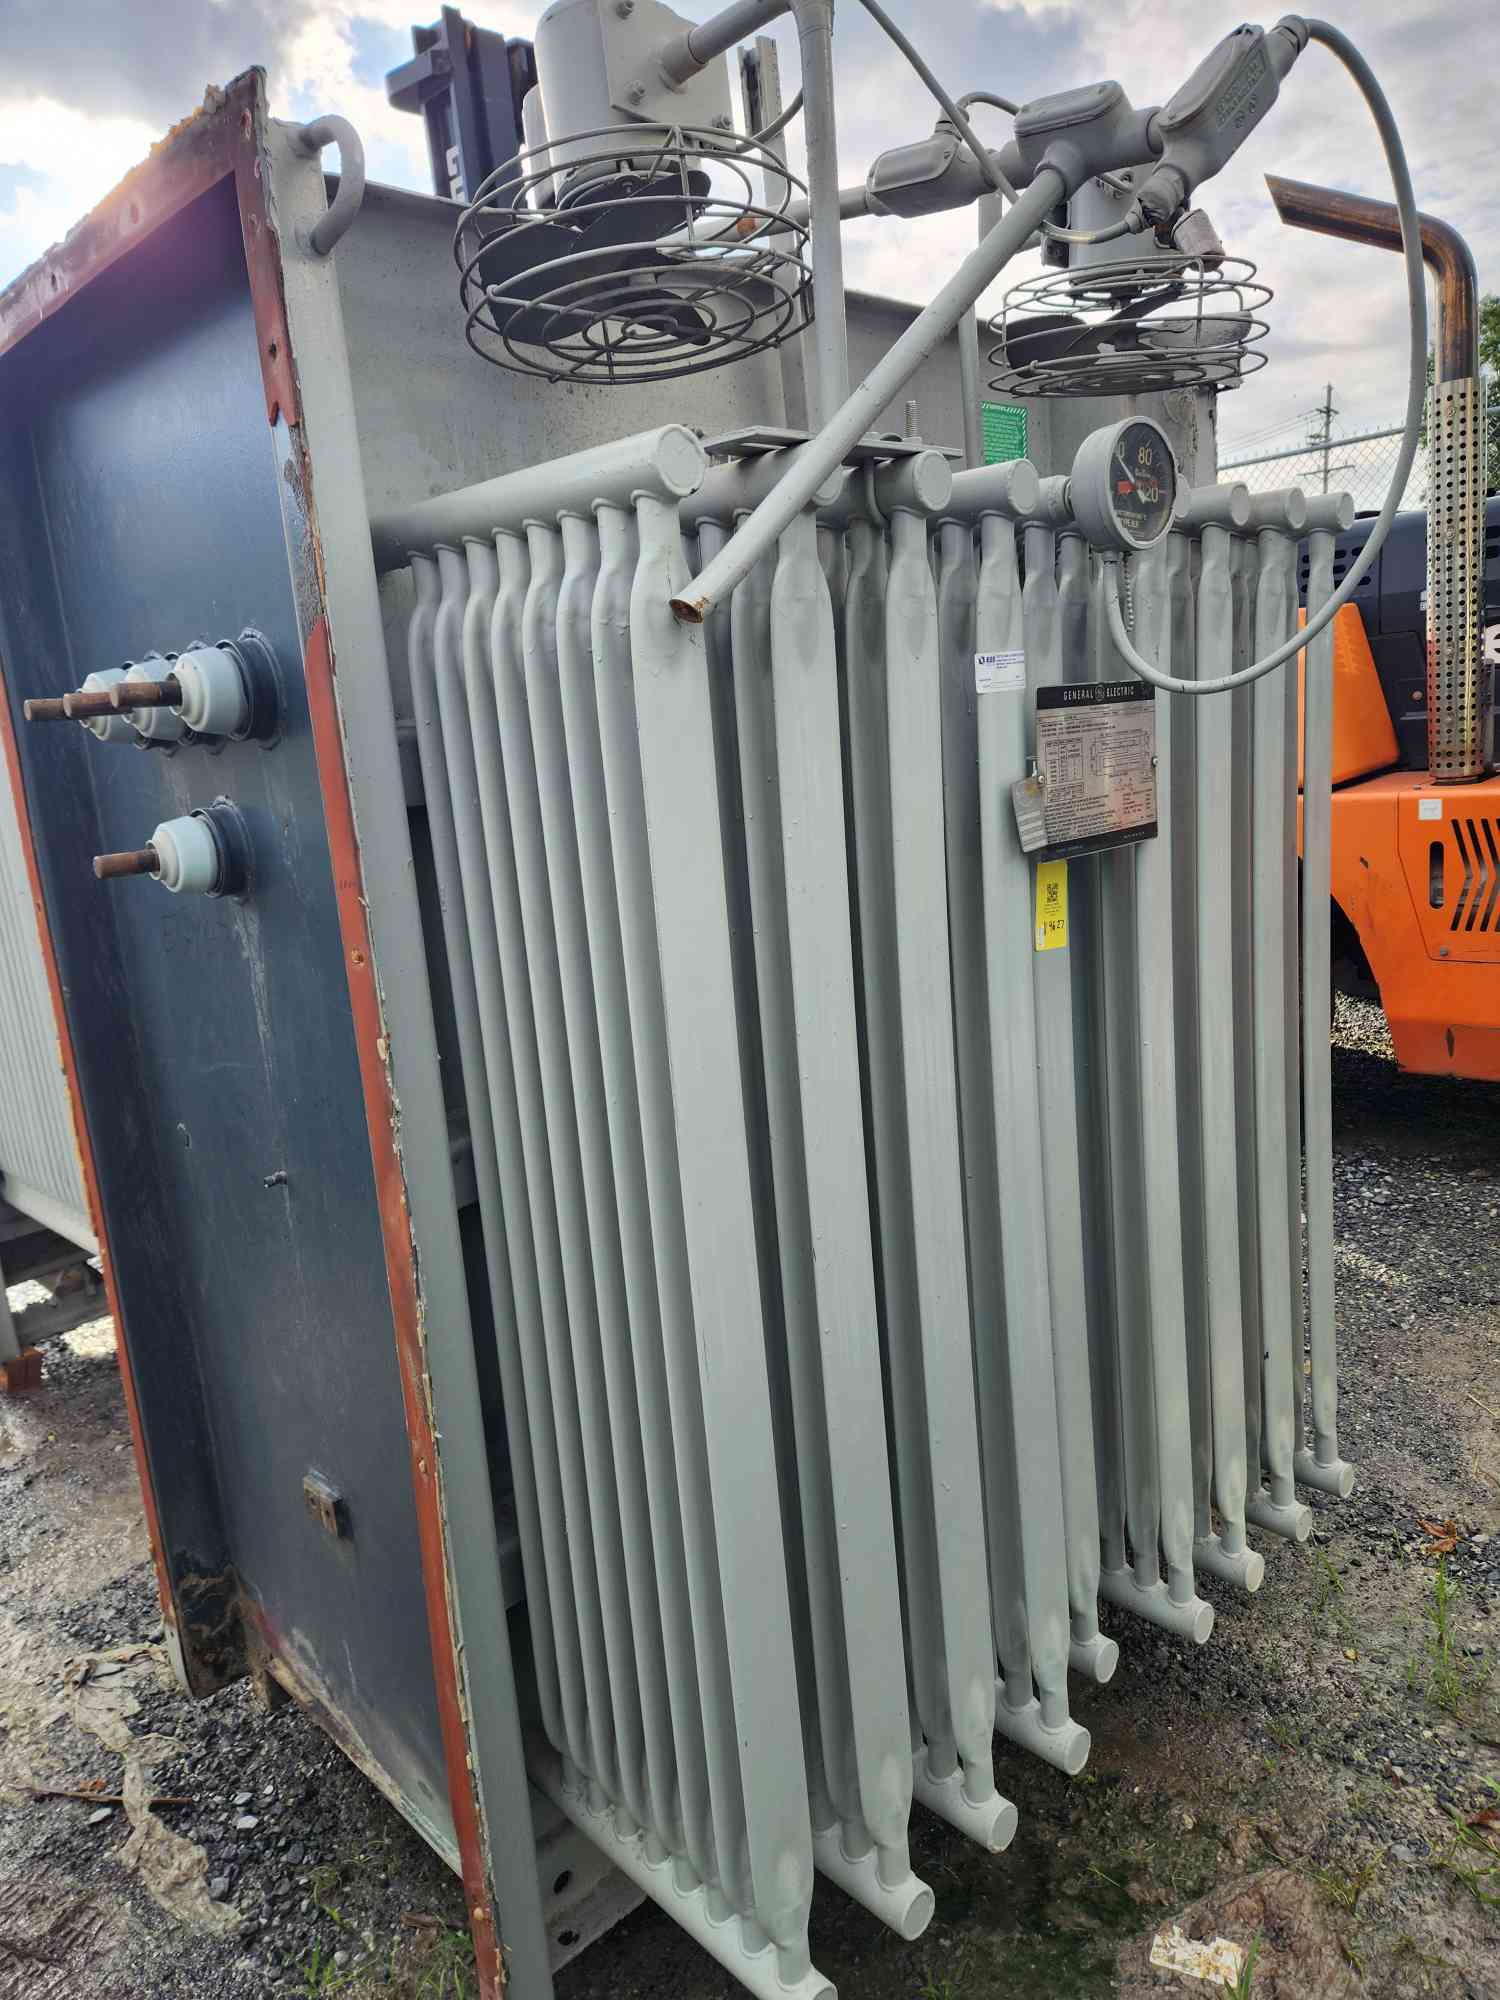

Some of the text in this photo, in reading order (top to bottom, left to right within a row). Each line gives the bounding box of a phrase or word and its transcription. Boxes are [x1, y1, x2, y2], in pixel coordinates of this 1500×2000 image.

[1138, 447, 1153, 466] 80
[1063, 690, 1094, 700] GENERAL
[1106, 686, 1134, 697] ELECTRIC
